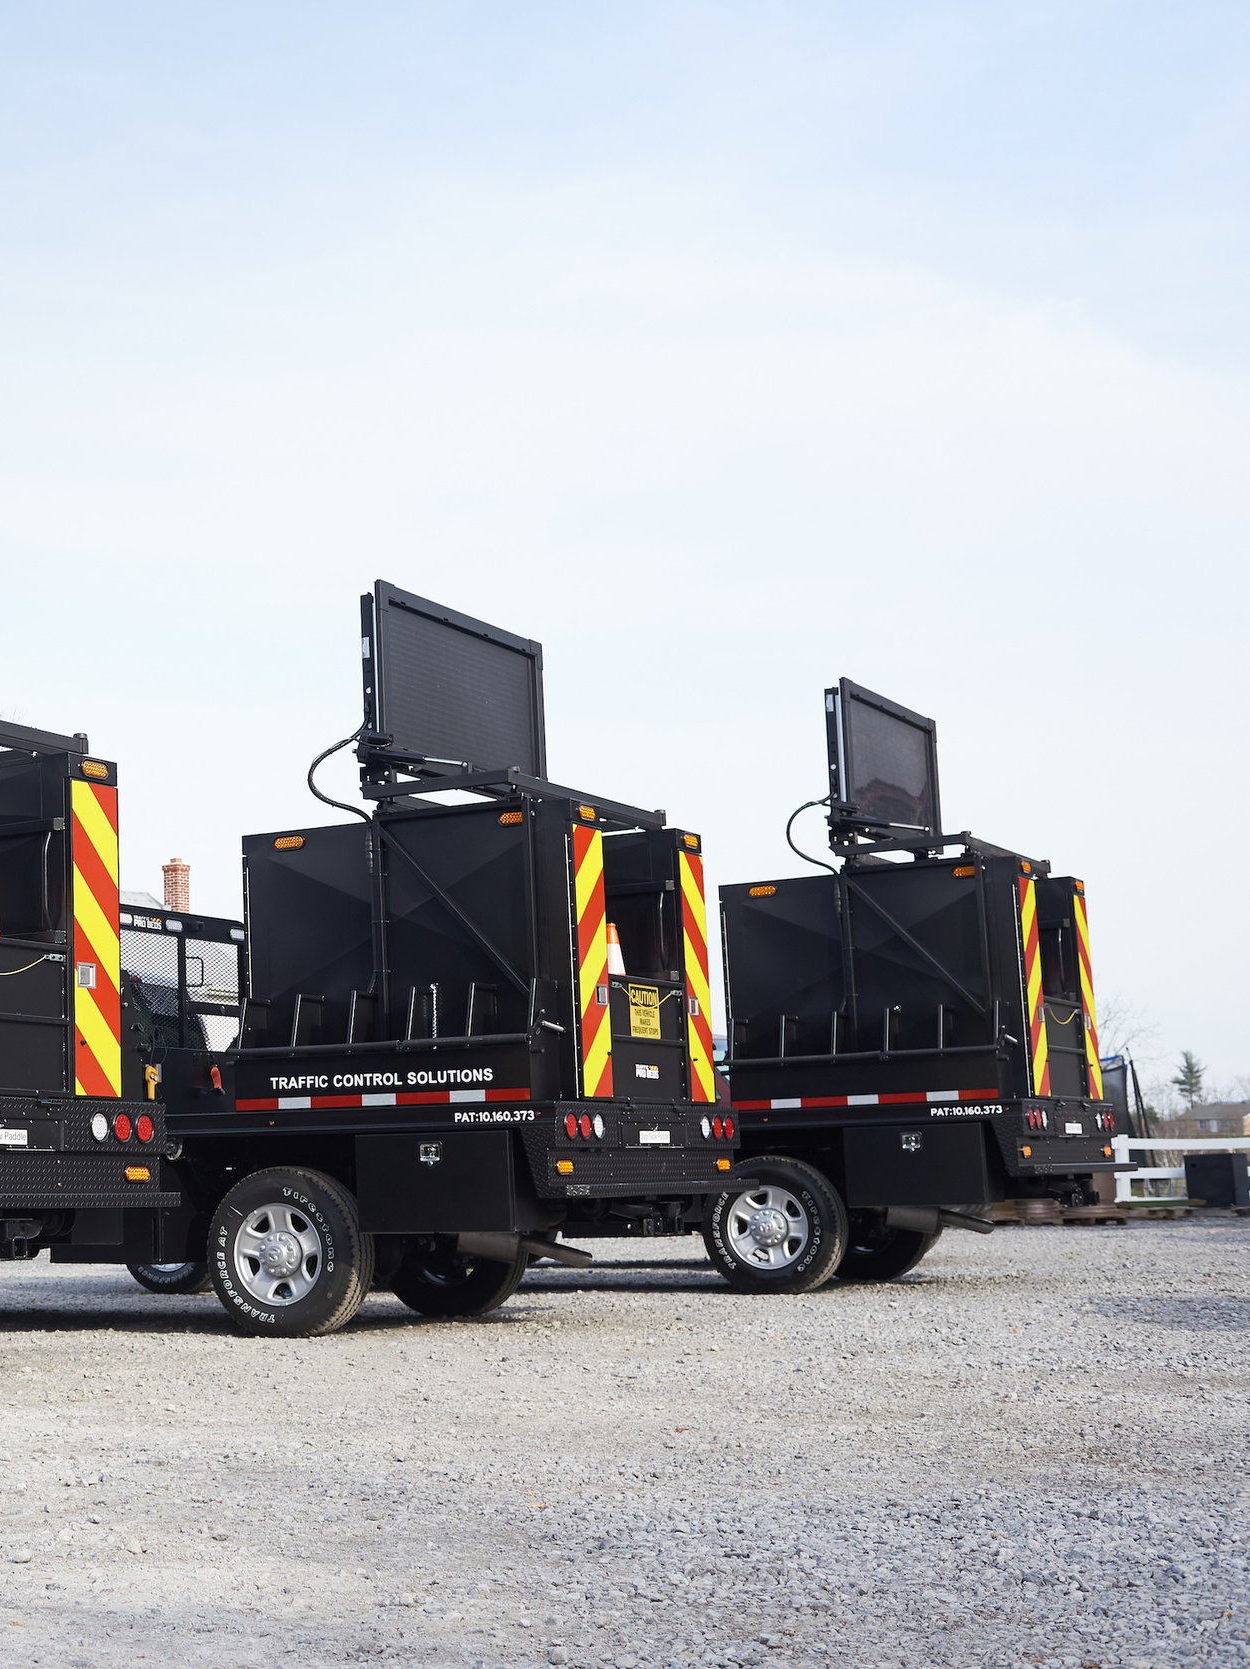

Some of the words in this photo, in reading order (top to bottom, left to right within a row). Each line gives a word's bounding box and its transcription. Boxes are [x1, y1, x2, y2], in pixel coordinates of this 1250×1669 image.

[631, 989, 658, 1006] CAUTION
[270, 1074, 329, 1090] TRAFFIC
[333, 1072, 403, 1088] CONTROL
[407, 1068, 494, 1085] SOLUTIONS
[4, 1131, 27, 1141] Paddle
[218, 1226, 229, 1247] AT
[216, 1251, 276, 1324] TRANSFORCE
